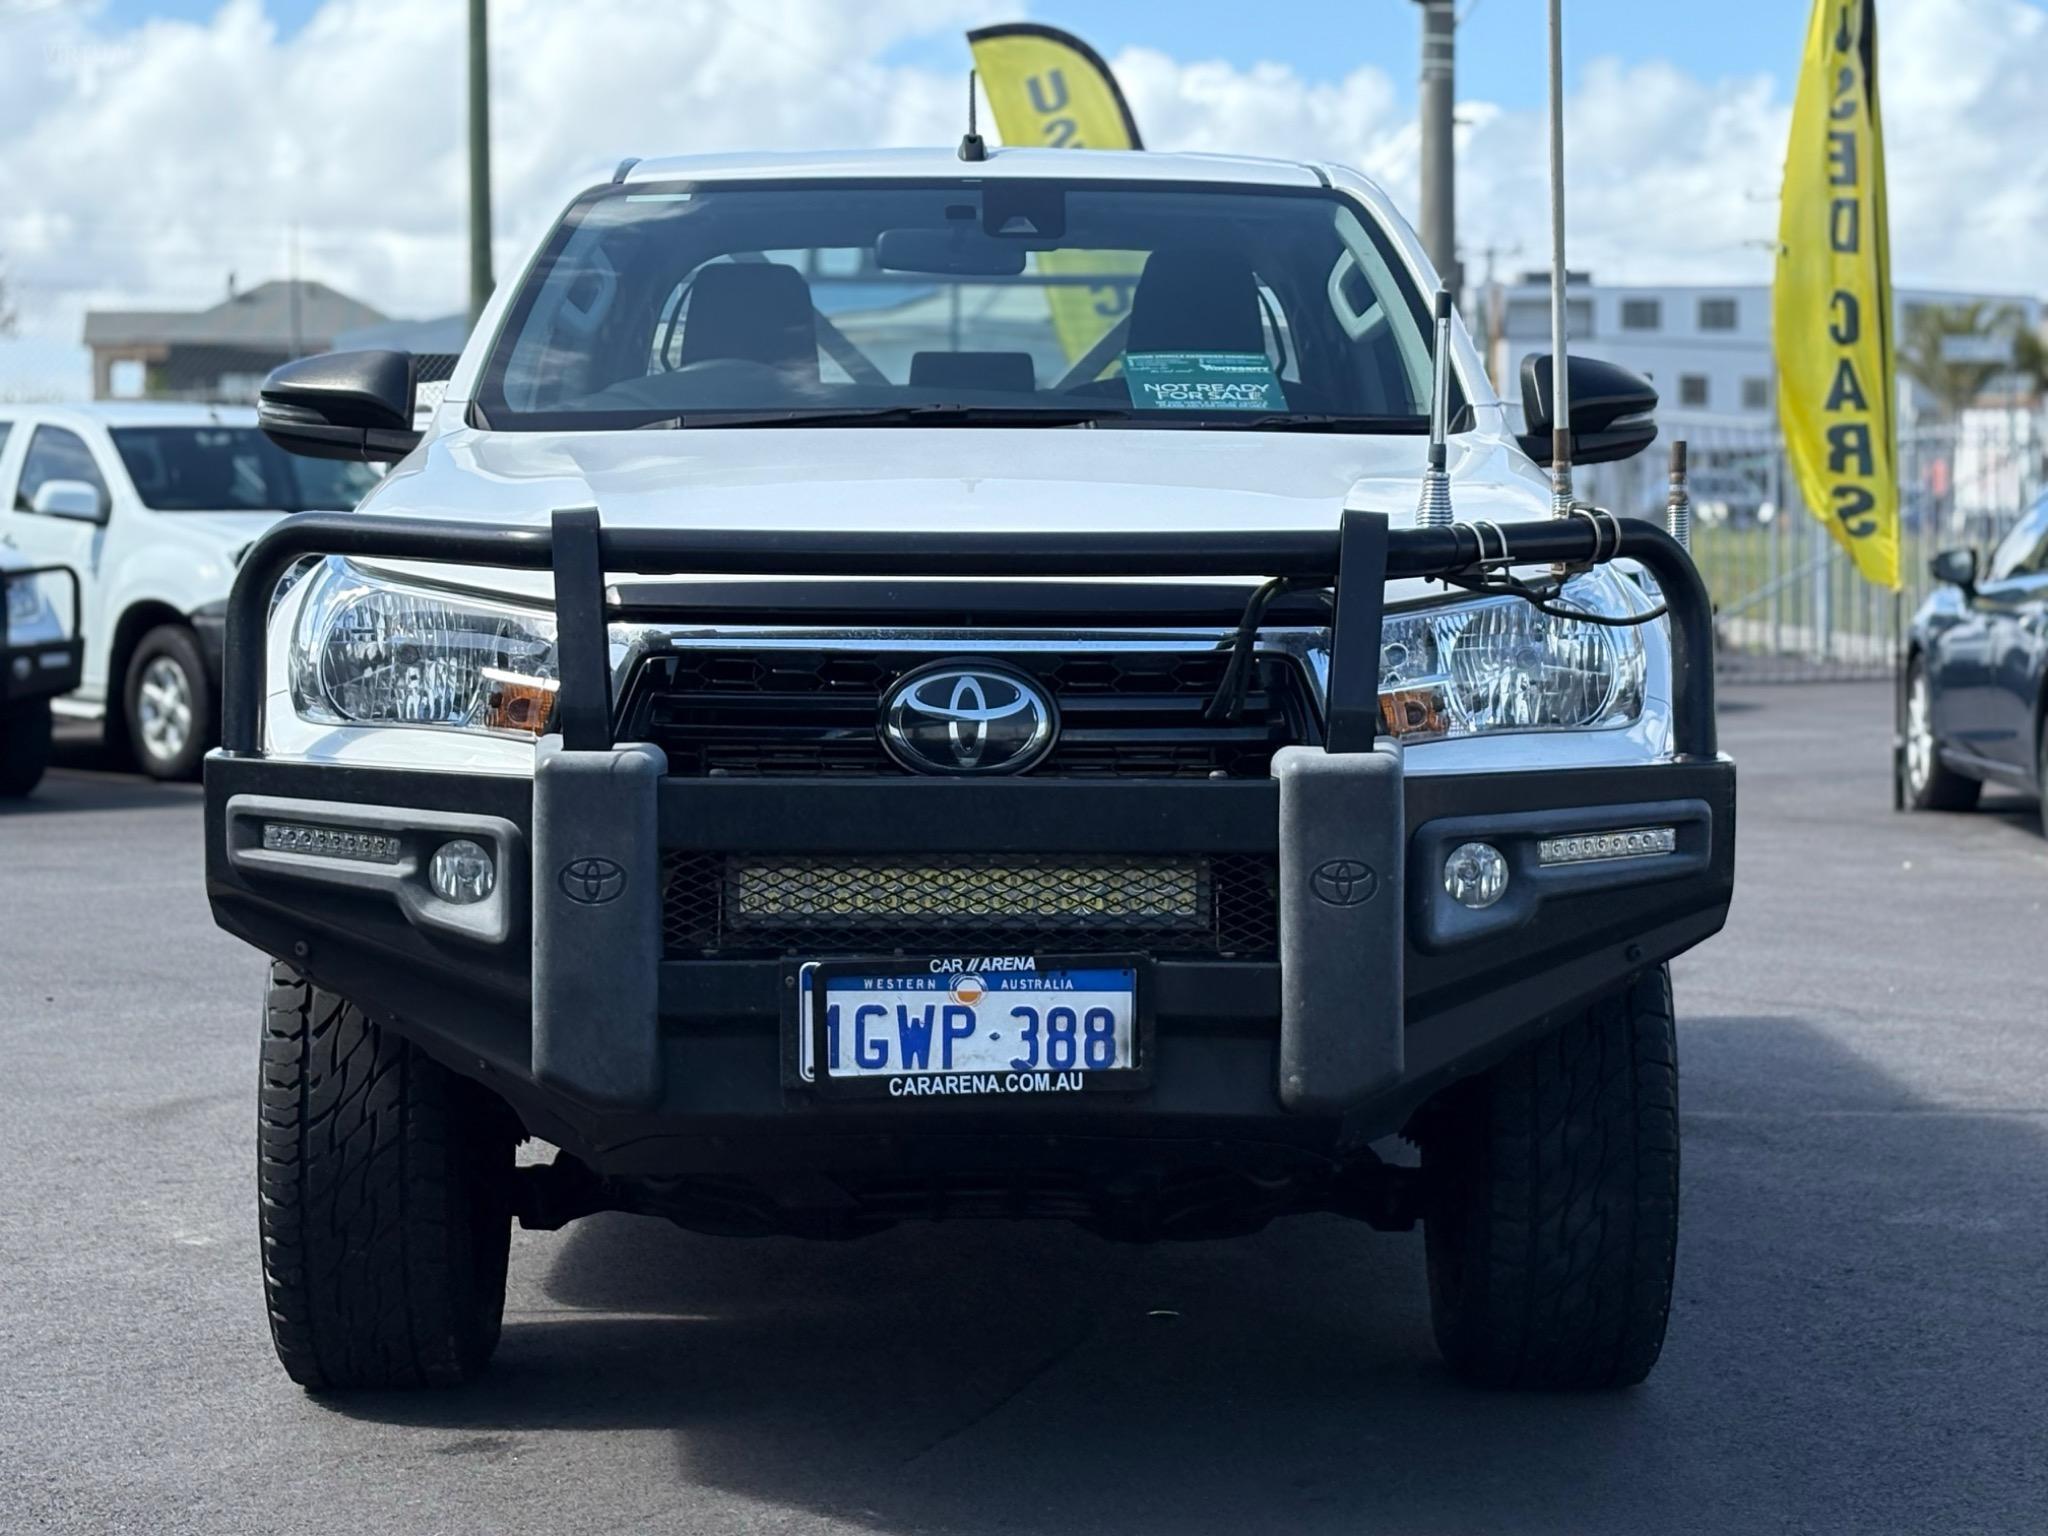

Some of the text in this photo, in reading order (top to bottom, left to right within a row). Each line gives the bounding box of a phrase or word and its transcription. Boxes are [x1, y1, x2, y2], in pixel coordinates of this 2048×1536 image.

[1143, 383, 1270, 393] NOT READY
[1157, 391, 1263, 401] FOR SALE
[929, 958, 964, 973] CAR
[863, 978, 1074, 990] WESTERN AUSTRALIA
[889, 1072, 1084, 1096] CARARENA.COM.AU
